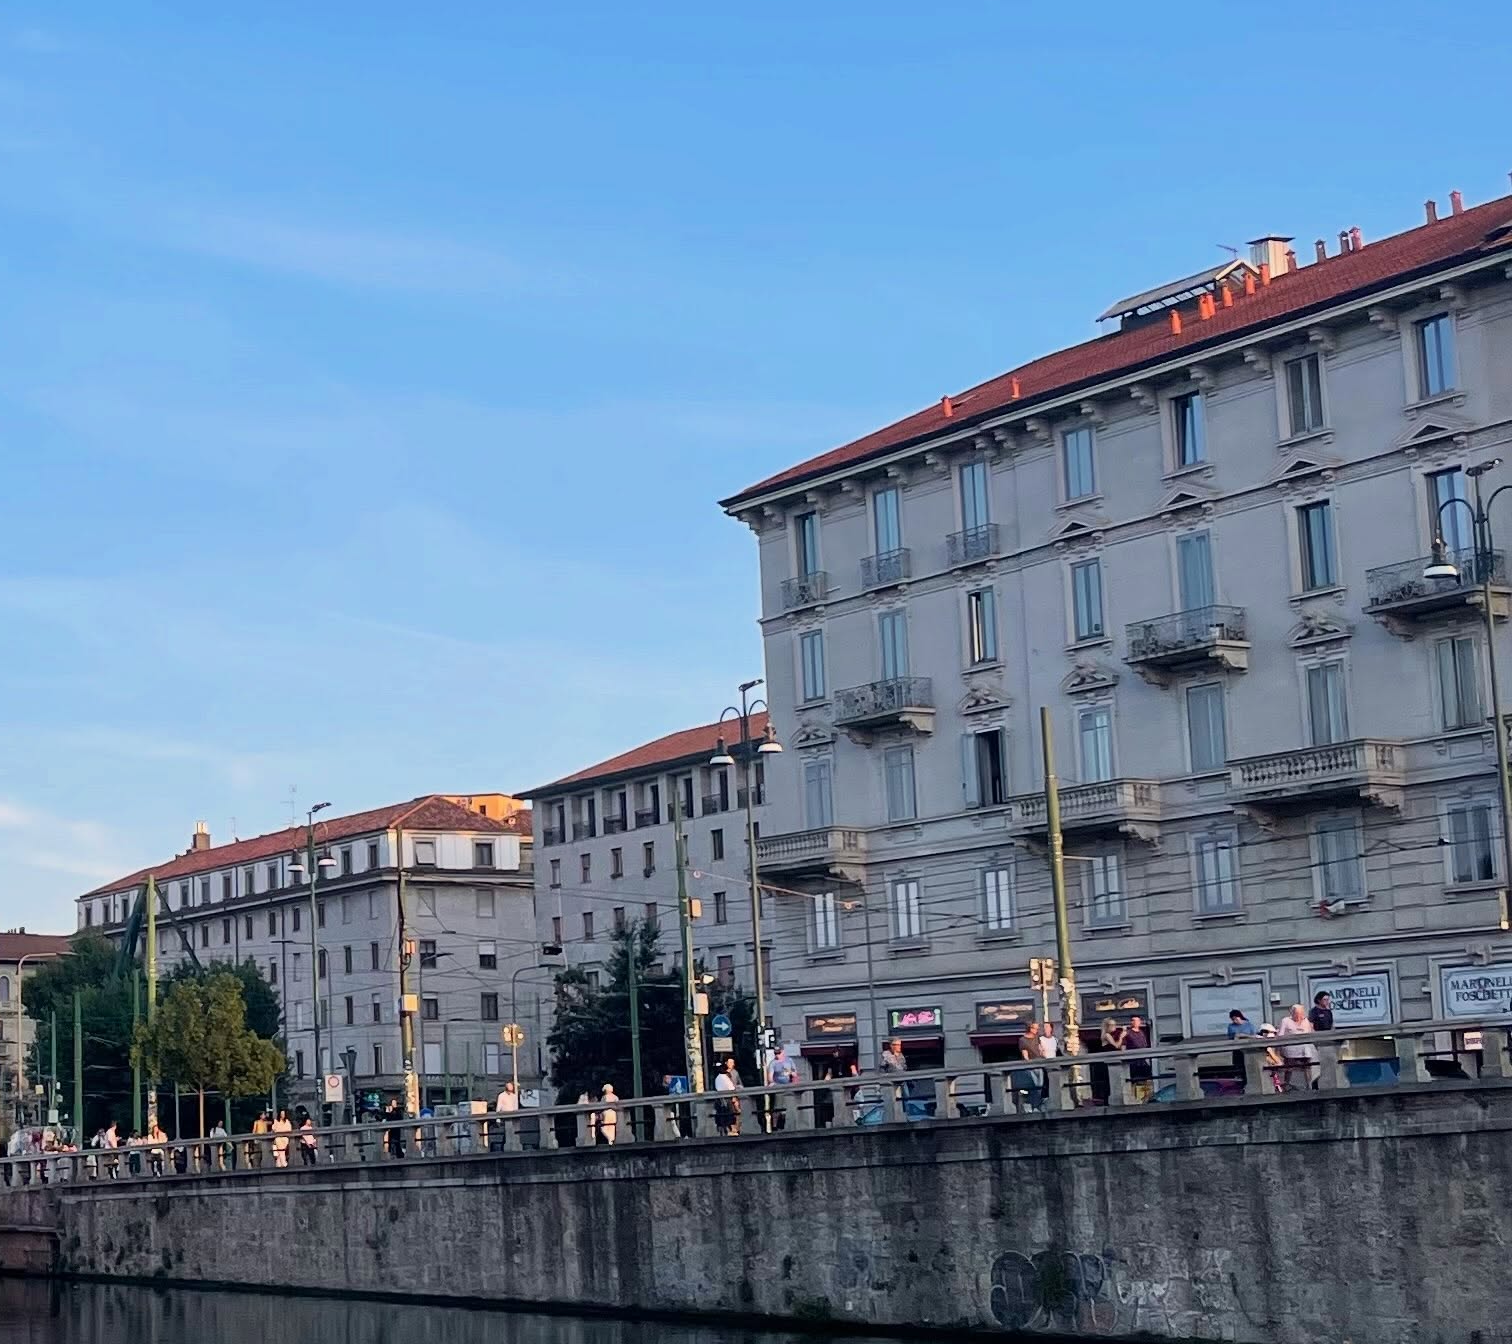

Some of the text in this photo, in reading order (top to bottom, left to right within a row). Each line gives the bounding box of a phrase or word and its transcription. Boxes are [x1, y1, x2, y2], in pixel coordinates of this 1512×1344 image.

[1450, 976, 1512, 990] MARTINELL
[1329, 985, 1381, 999] ARTINELLI
[1455, 988, 1512, 1002] FOSCHETT
[1329, 997, 1378, 1011] OSCHETTI
